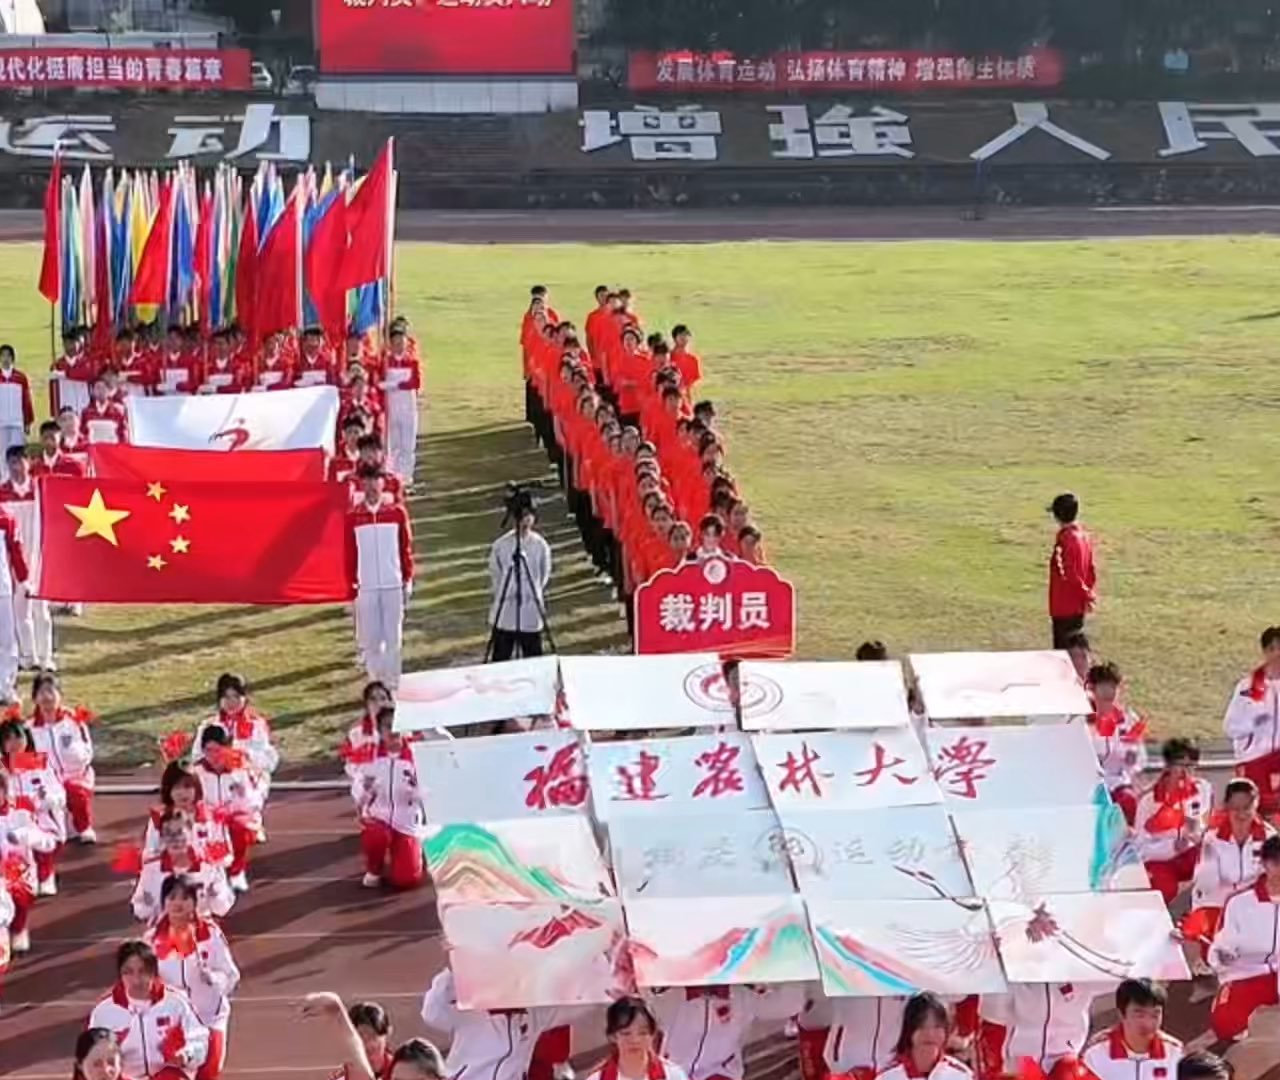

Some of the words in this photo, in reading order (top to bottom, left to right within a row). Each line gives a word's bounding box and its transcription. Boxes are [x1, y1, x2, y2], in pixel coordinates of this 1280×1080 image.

[656, 57, 776, 82] 发展体育运动
[659, 592, 770, 632] 裁判员
